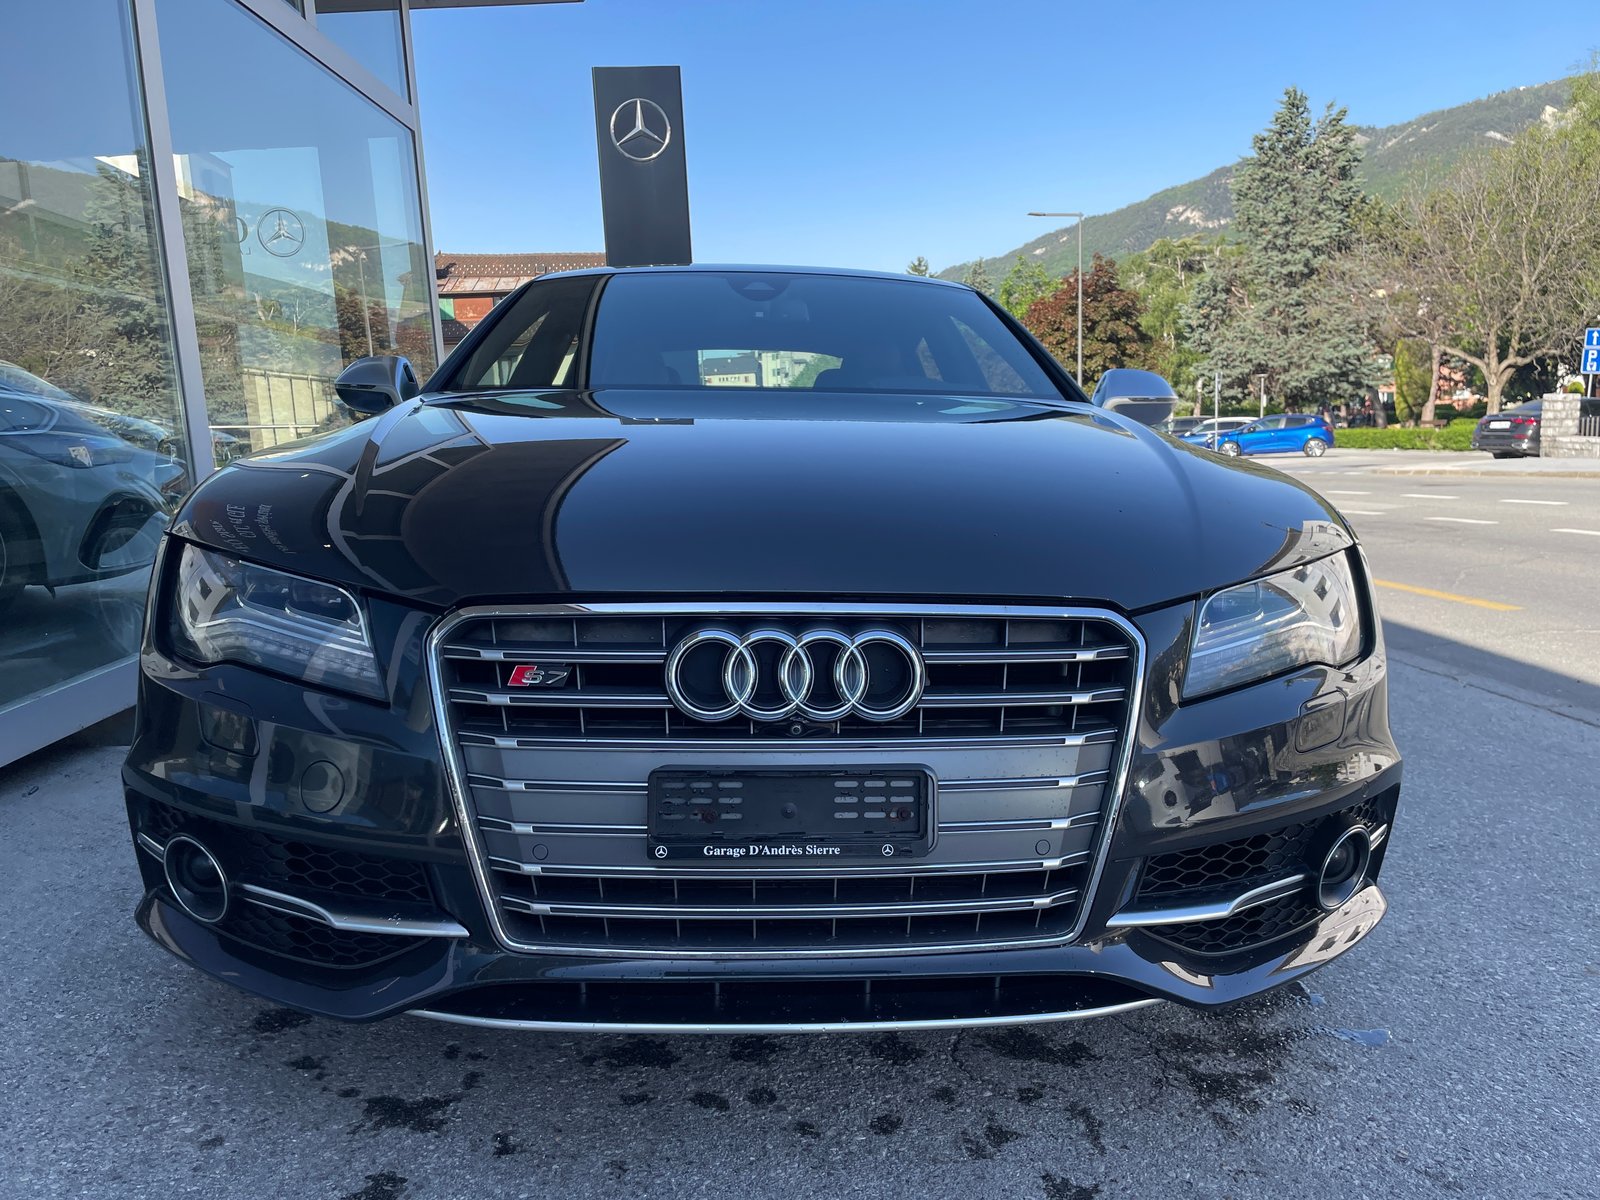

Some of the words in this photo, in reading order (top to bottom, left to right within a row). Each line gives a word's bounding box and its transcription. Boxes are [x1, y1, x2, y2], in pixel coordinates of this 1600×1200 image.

[1588, 350, 1597, 363] P
[521, 670, 568, 684] S7
[703, 845, 746, 858] Garage
[805, 844, 841, 855] Sierre
